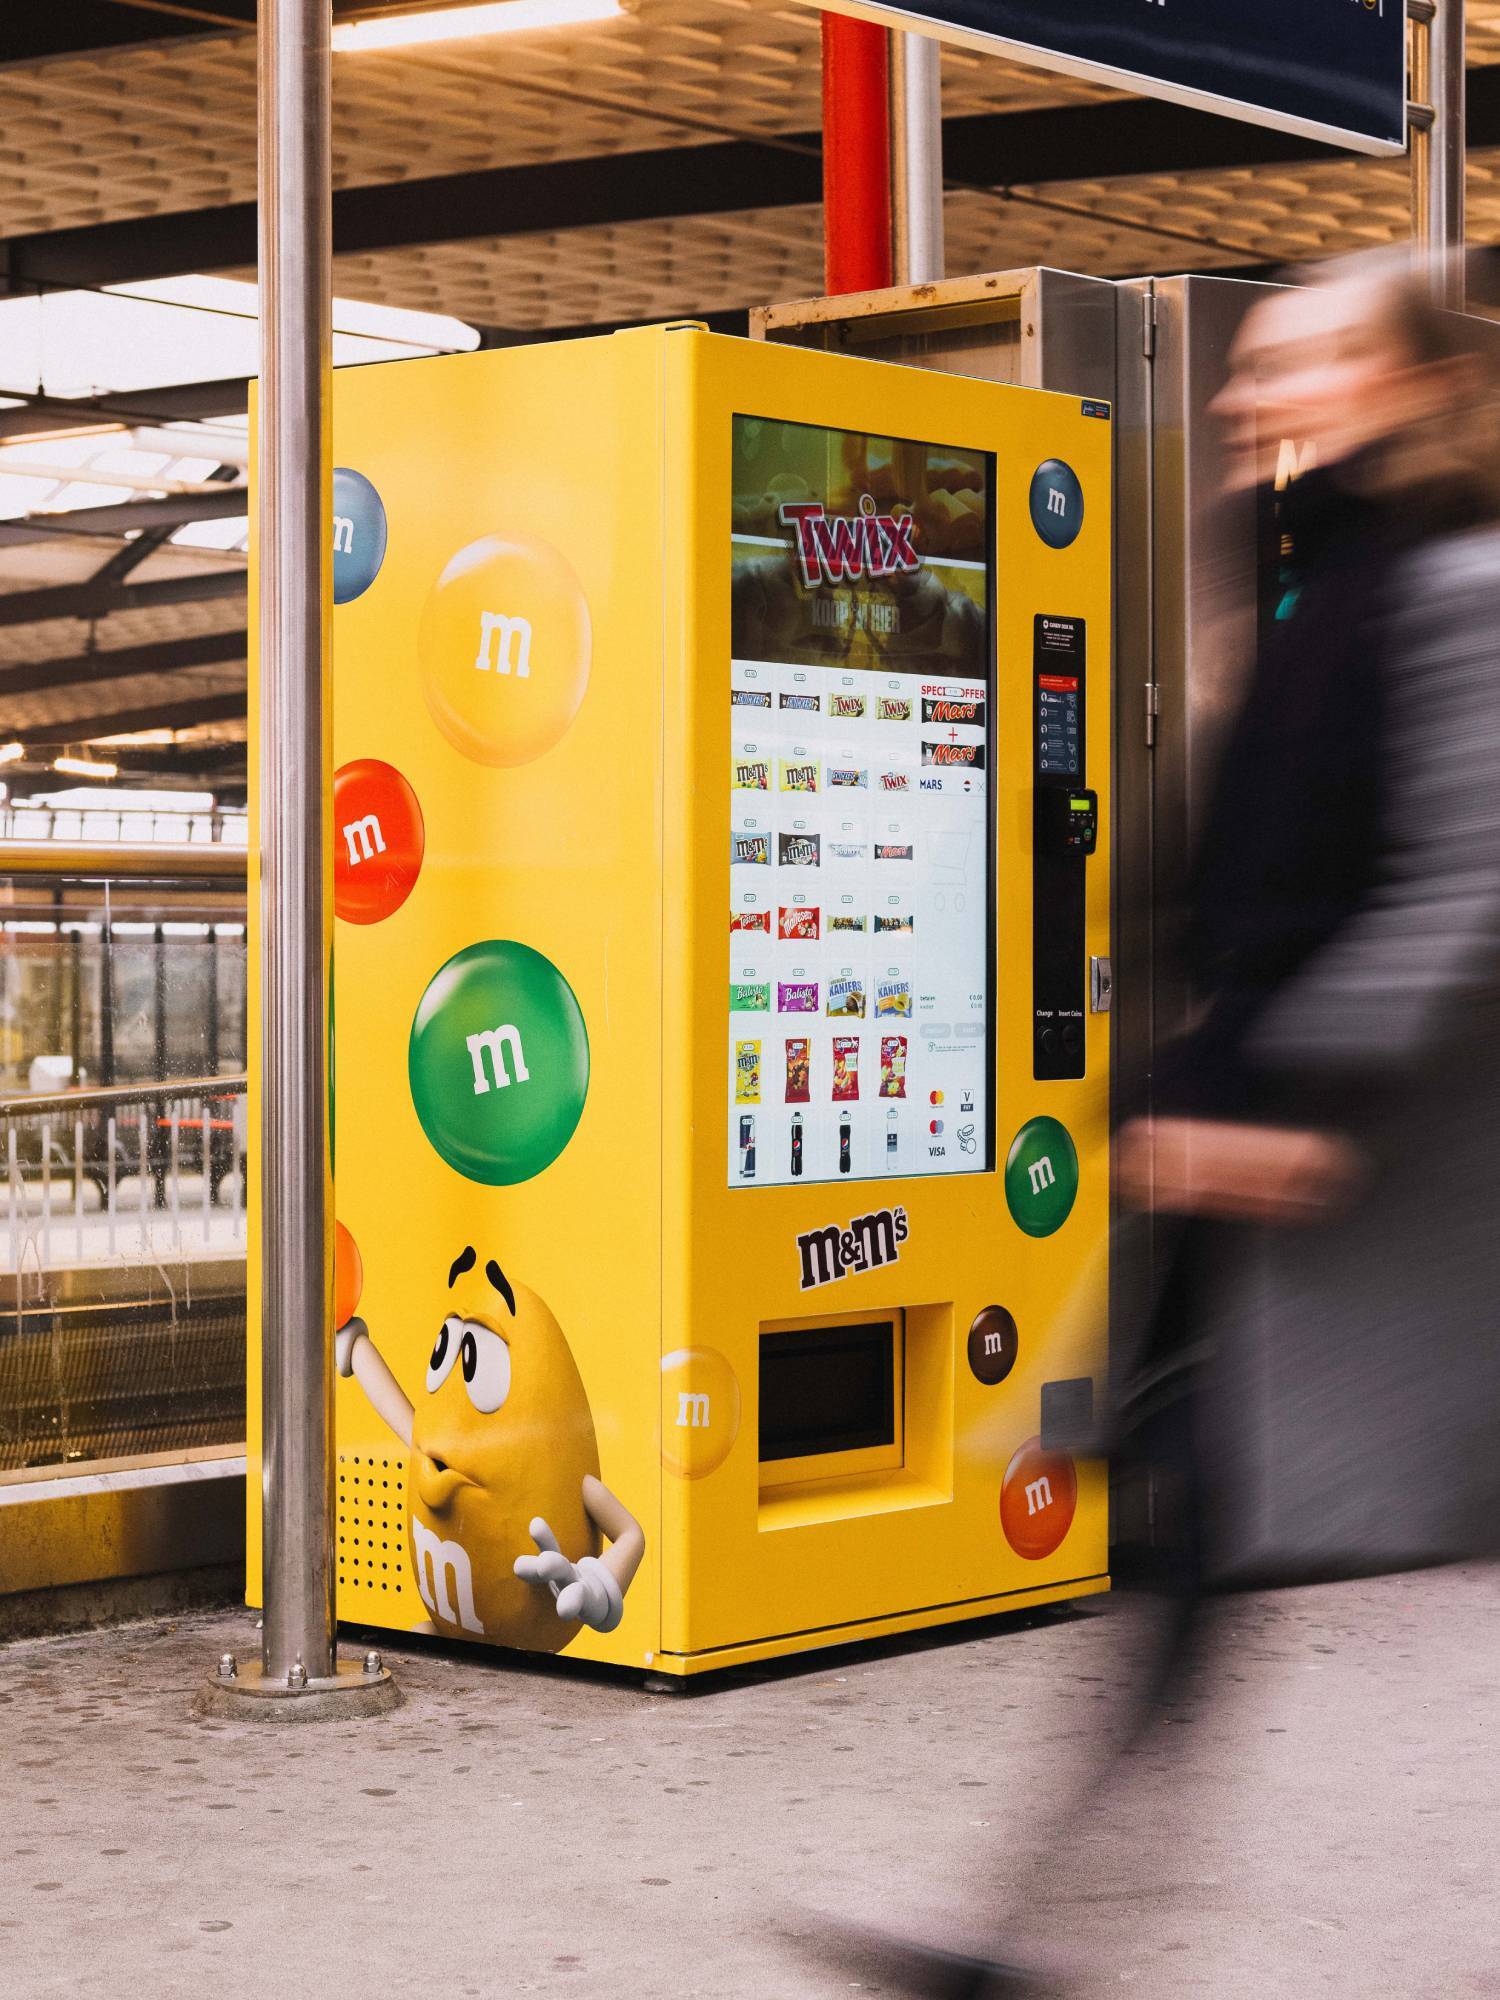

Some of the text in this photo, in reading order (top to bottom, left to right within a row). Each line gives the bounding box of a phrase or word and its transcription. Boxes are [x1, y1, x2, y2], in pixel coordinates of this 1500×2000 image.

[1047, 487, 1066, 517] m
[475, 611, 532, 678] m
[931, 701, 977, 721] Mars
[931, 744, 977, 765] Mars
[920, 779, 943, 790] MARS
[342, 814, 387, 866] m
[1036, 1009, 1053, 1018] Change
[1058, 1009, 1070, 1017] Insert
[466, 1024, 530, 1095] m
[929, 1146, 946, 1157] VISA
[1027, 1156, 1056, 1196] m
[984, 1331, 1003, 1356] m
[676, 1391, 710, 1427] m
[1024, 1476, 1053, 1516] m
[413, 1514, 484, 1635] m
